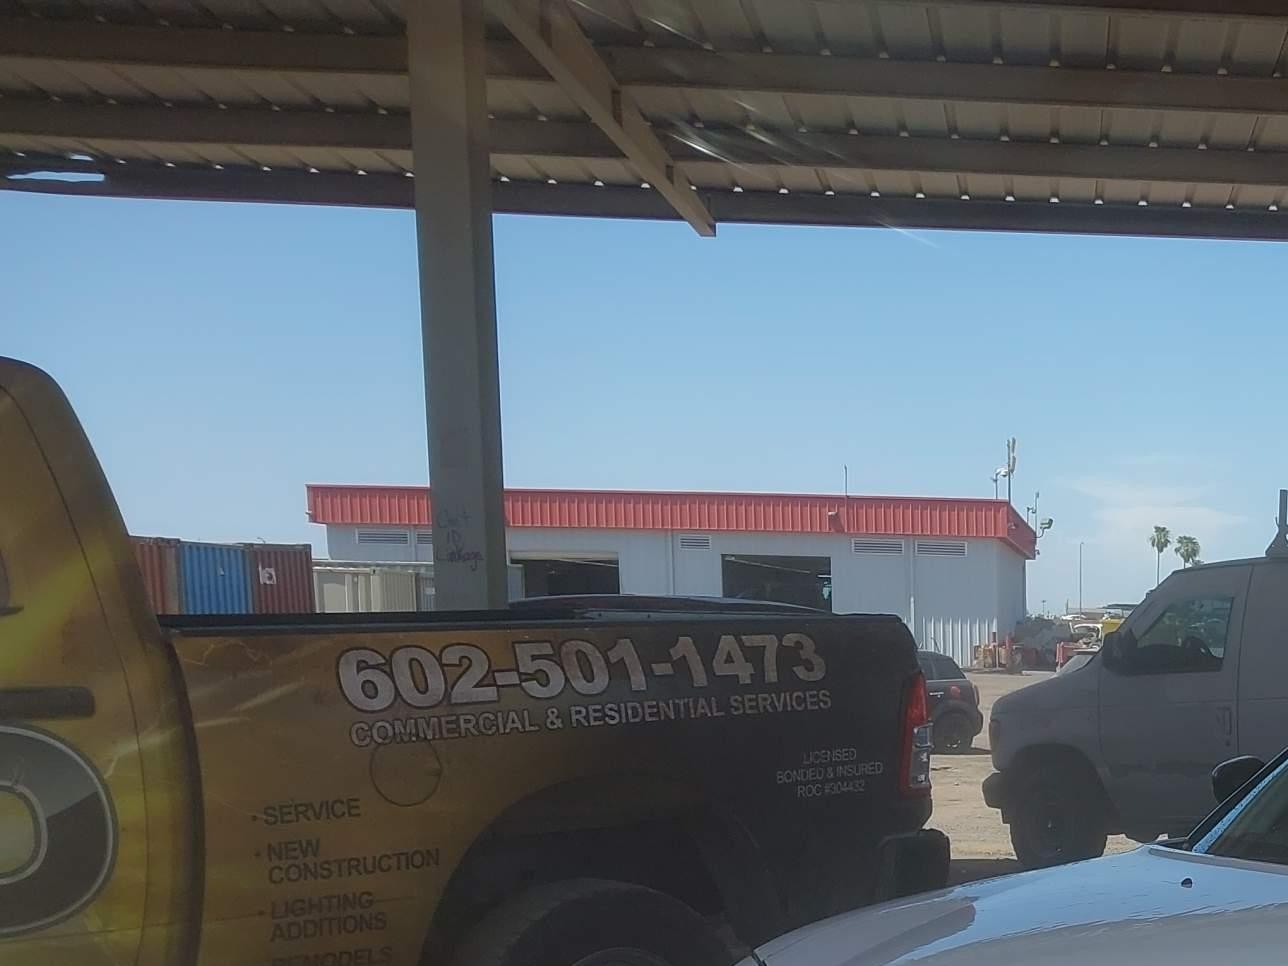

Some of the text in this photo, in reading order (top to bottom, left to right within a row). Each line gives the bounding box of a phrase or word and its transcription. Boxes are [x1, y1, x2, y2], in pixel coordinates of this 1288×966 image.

[336, 633, 827, 713] 602-501-1473
[350, 689, 832, 747] COMMERCIAL & RESIDENTIAL SERVICES
[802, 747, 857, 765] LICENSED
[775, 766, 825, 784] BONDED
[836, 761, 884, 778] INSURED
[797, 783, 822, 798] ROC
[263, 798, 361, 826] SERVICE
[267, 838, 321, 862] NEW
[268, 848, 441, 884] CONSTRUCTION
[271, 891, 374, 919] LIGHTING
[270, 911, 387, 943] ADDITIONS
